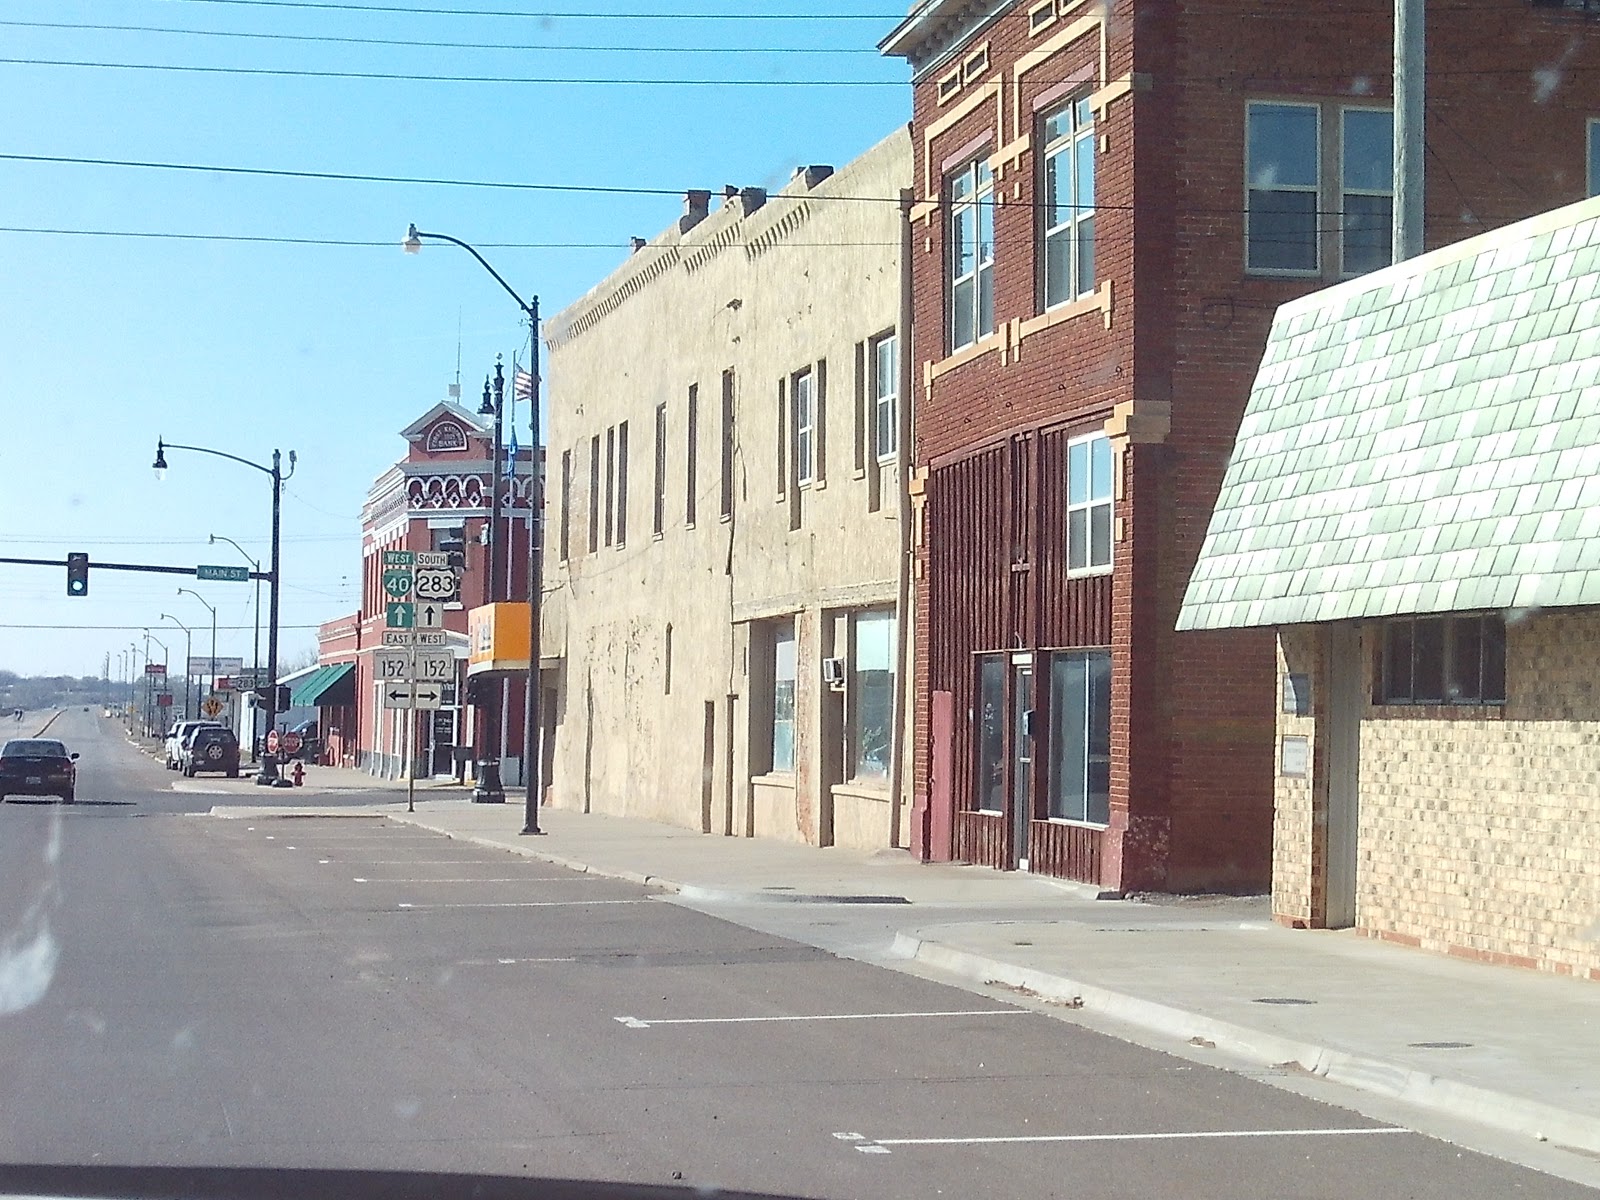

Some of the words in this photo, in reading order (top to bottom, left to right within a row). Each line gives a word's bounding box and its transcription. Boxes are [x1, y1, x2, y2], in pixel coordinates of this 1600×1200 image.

[387, 552, 410, 564] WEST
[418, 553, 447, 565] SOUTH
[204, 569, 228, 577] MAIN
[386, 577, 409, 592] 40
[419, 575, 453, 593] 283
[386, 633, 408, 644] EAST
[420, 634, 443, 644] WEST
[381, 660, 405, 677] 152
[424, 660, 446, 677] 152
